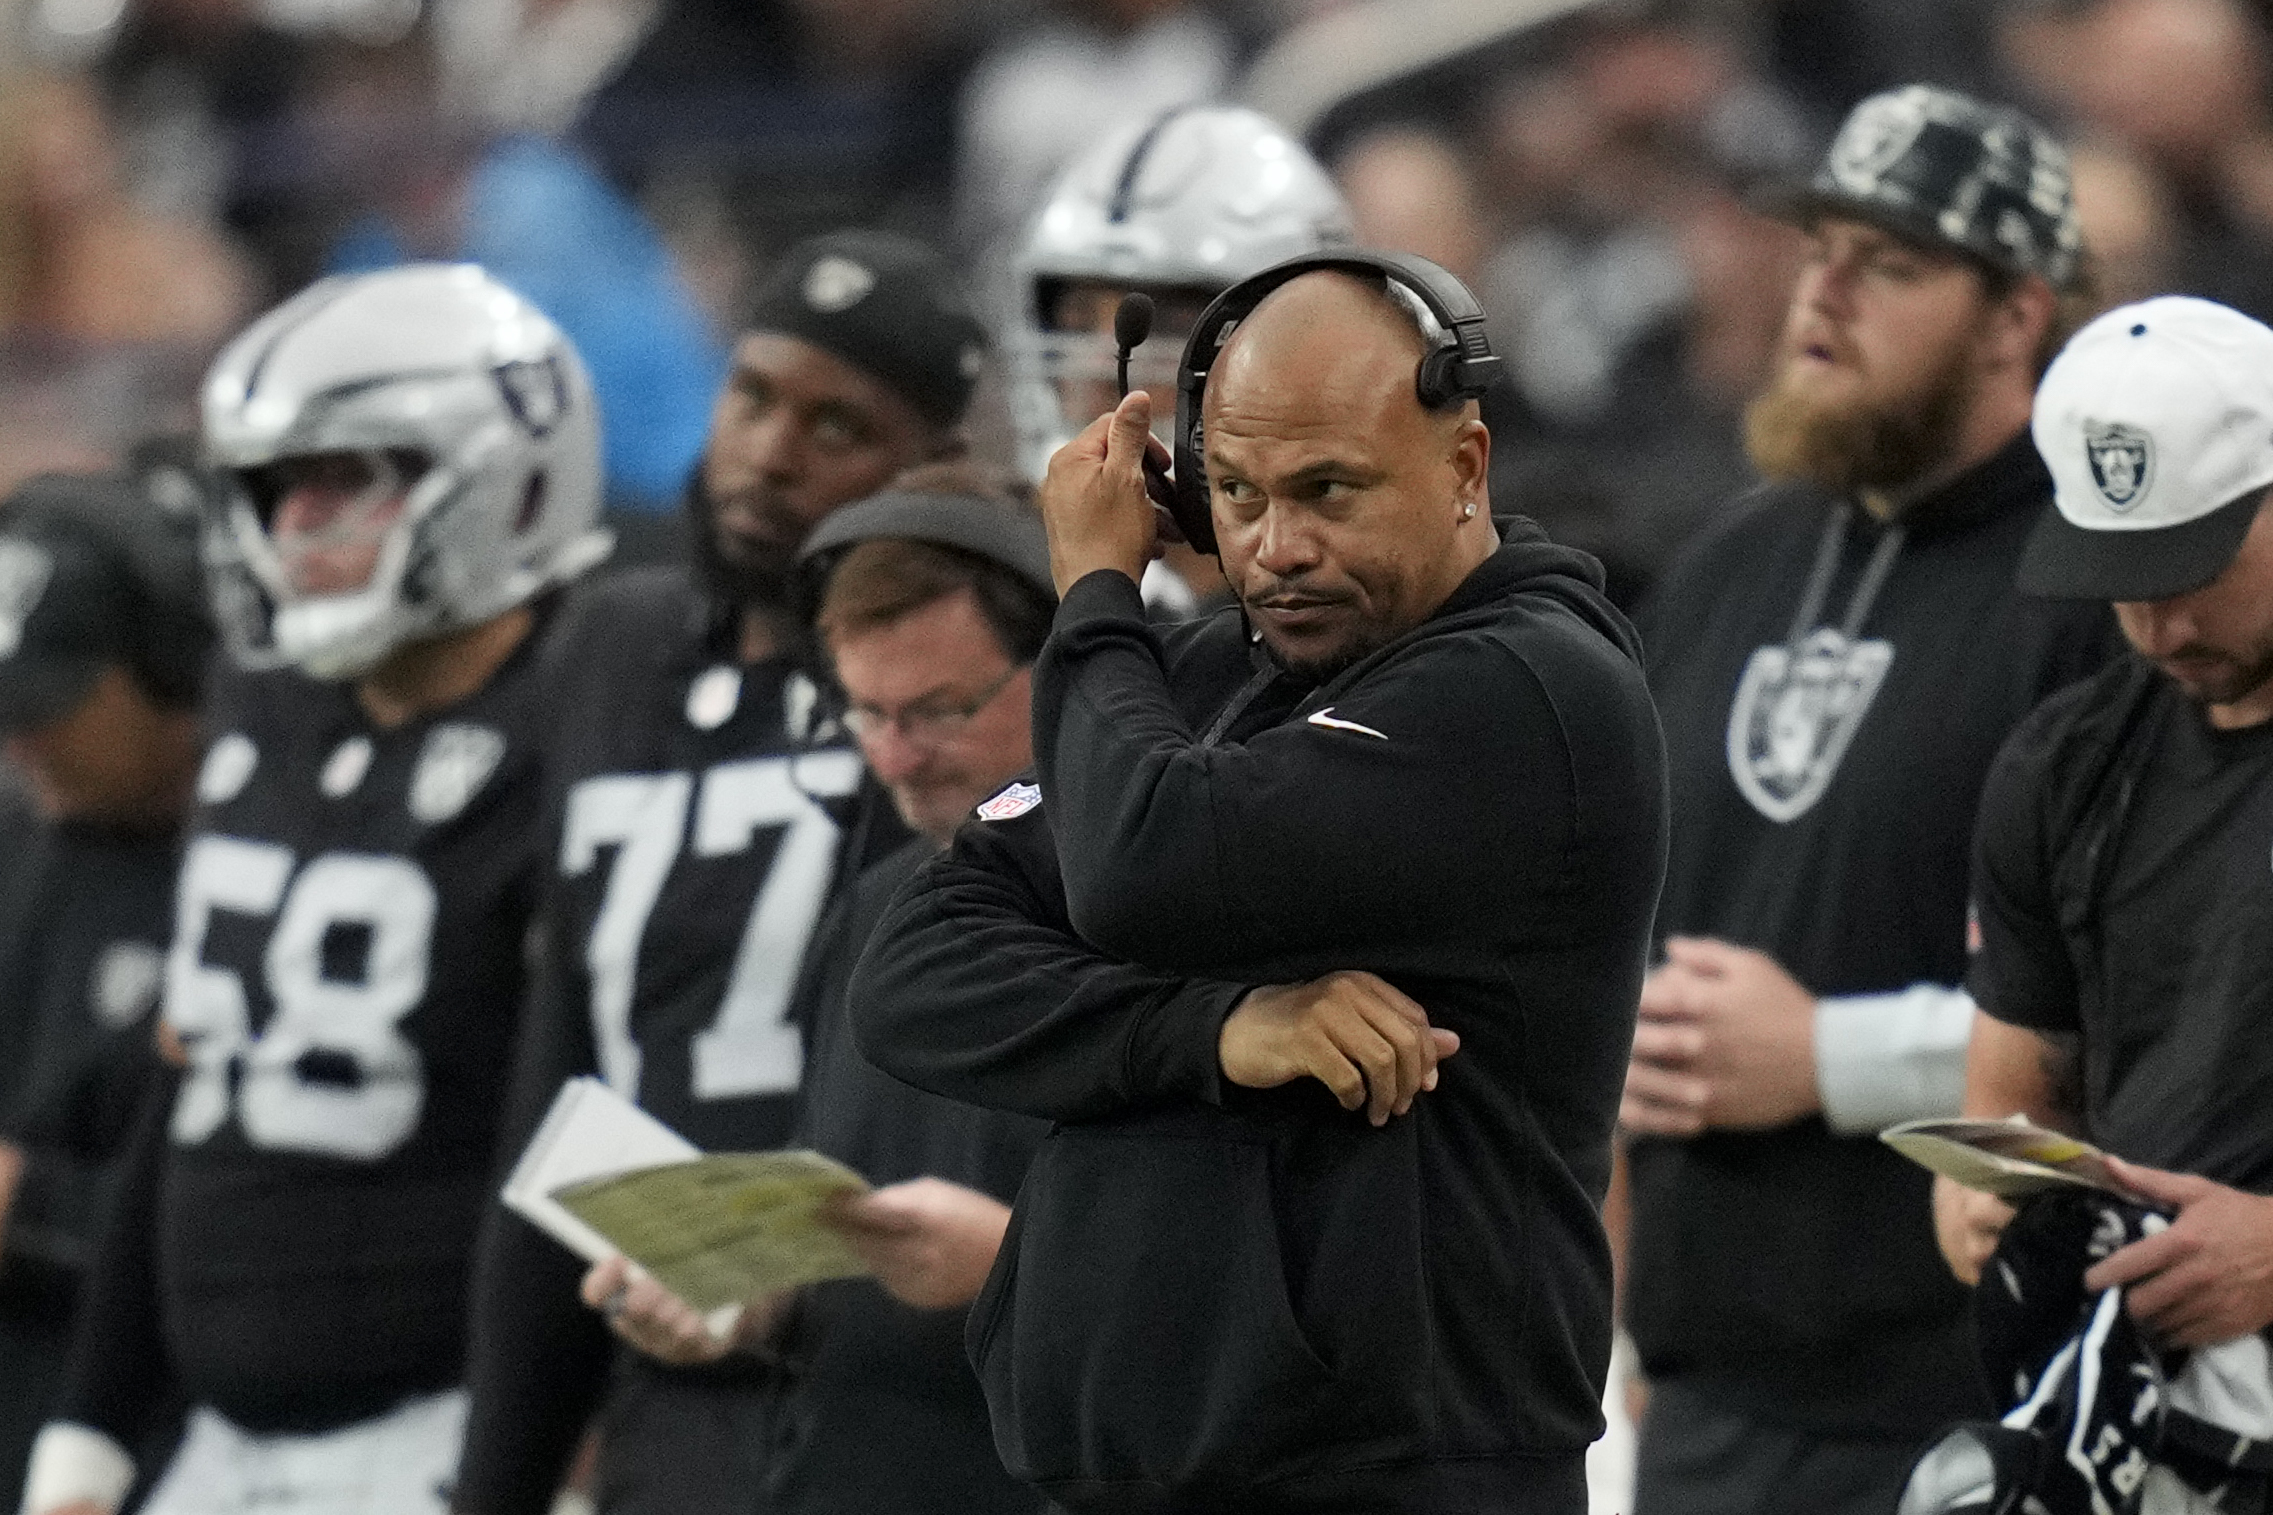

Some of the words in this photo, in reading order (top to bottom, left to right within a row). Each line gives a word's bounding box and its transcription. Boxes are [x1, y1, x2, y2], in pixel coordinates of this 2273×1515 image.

[561, 751, 863, 1100] 77
[986, 798, 1025, 815] NFL
[166, 835, 437, 1159] 58
